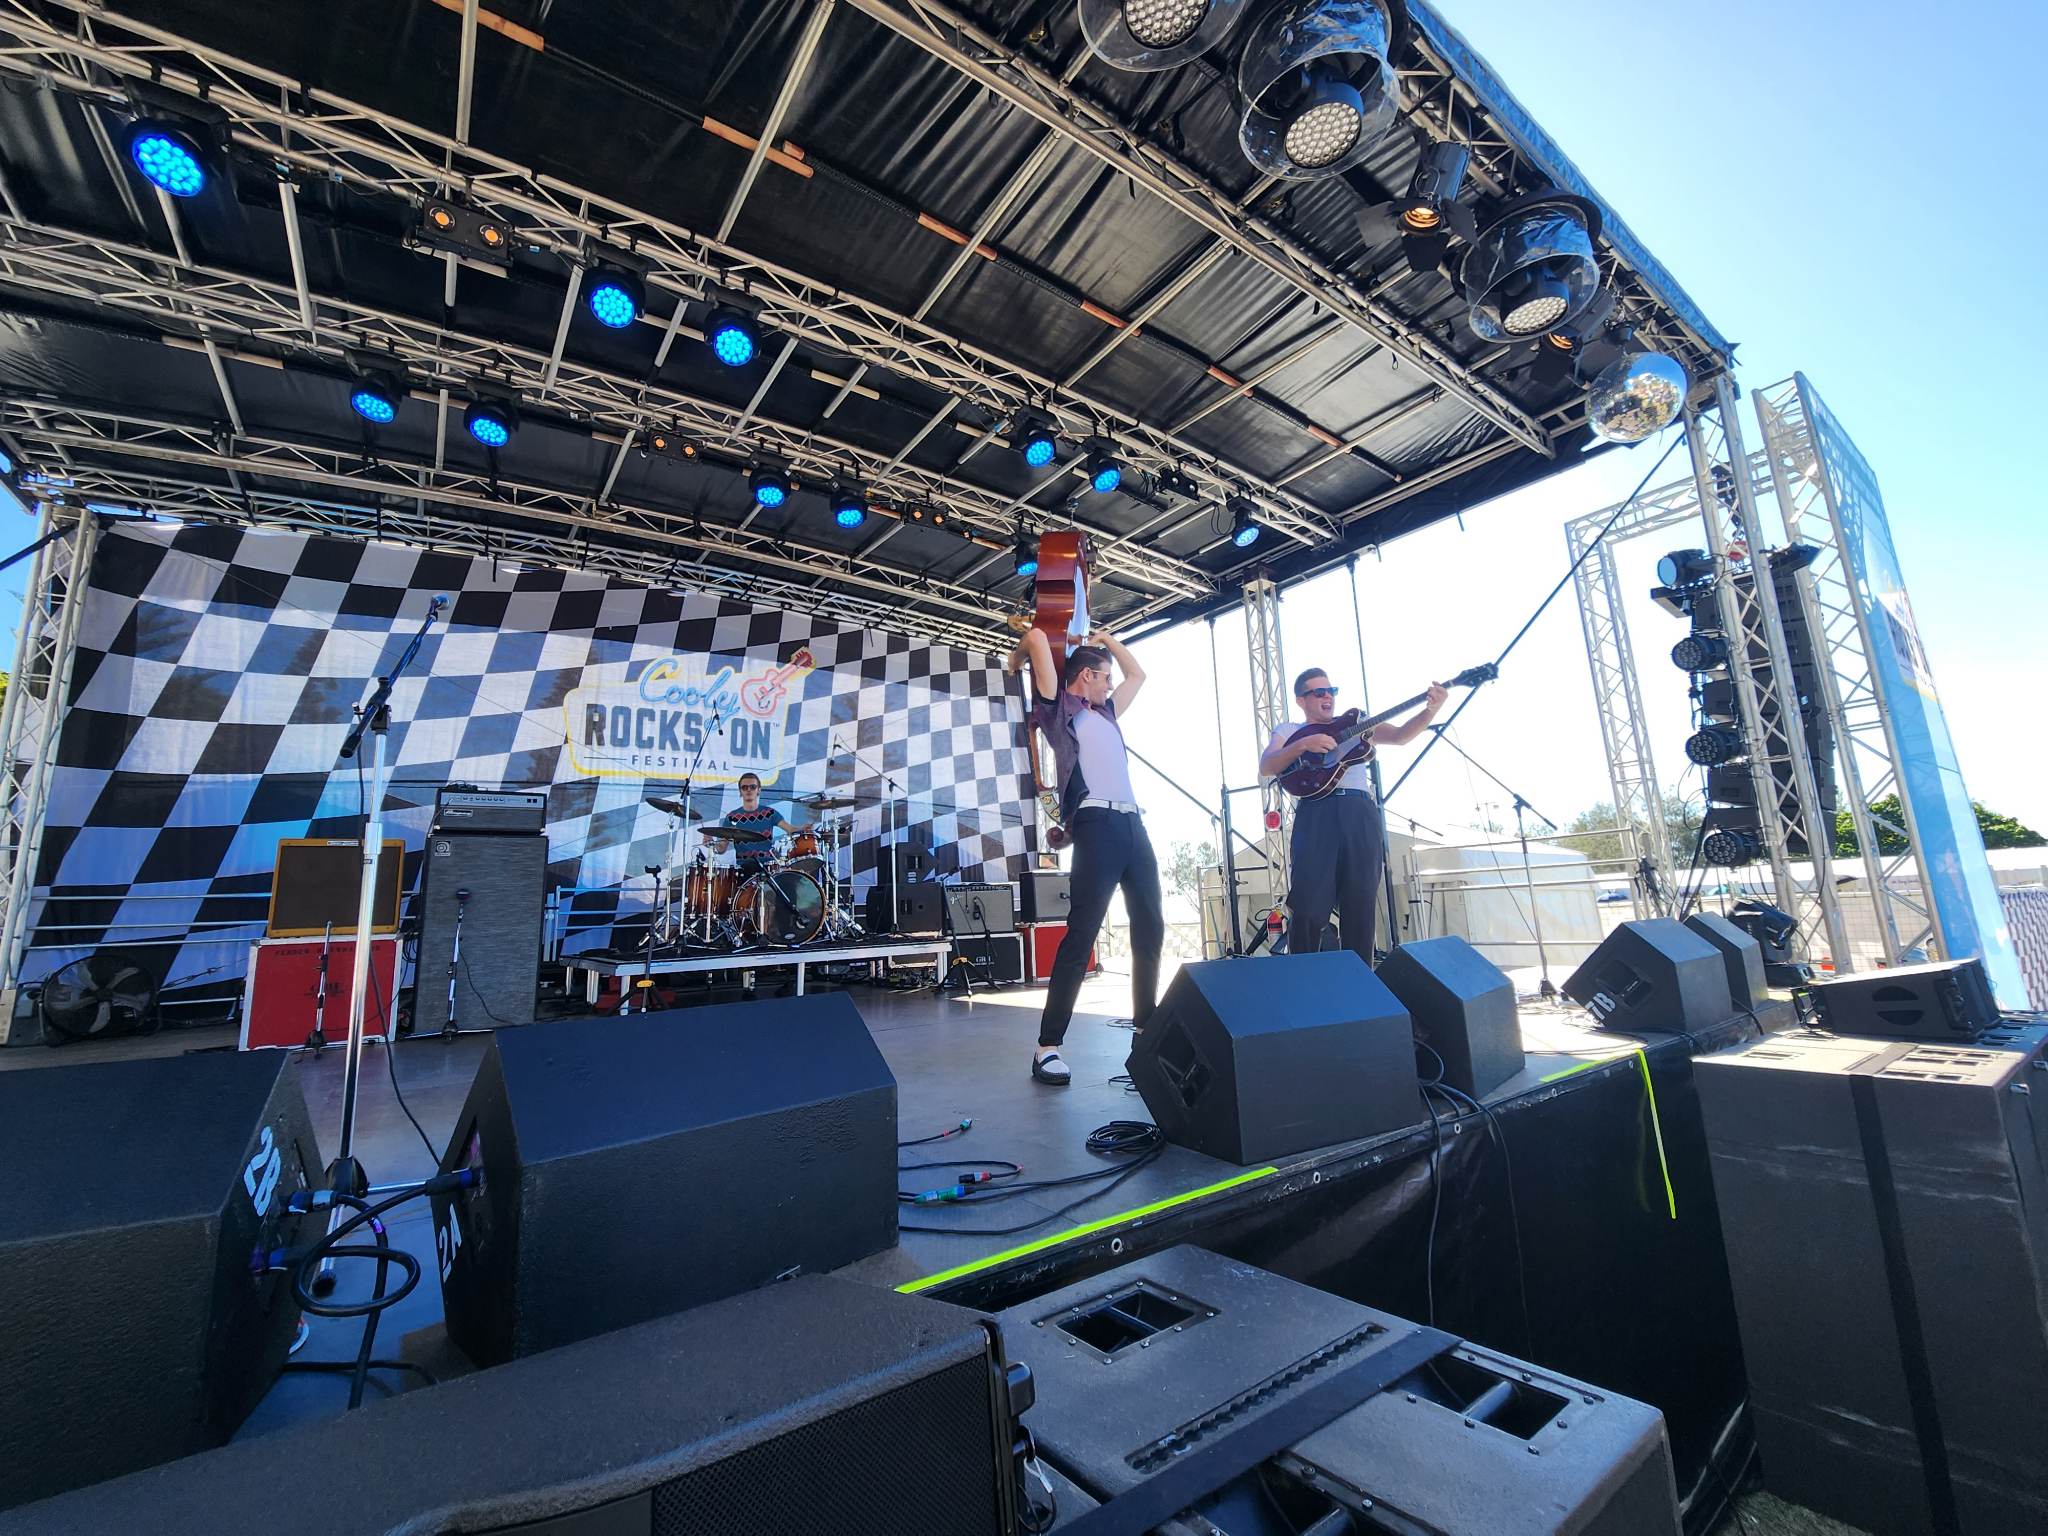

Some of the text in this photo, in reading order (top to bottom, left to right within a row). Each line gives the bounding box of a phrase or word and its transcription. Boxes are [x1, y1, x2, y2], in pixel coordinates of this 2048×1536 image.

[639, 658, 741, 731] Cooly
[584, 703, 772, 760] ROCKS ON
[631, 754, 729, 772] FESTIVAL
[1584, 991, 1617, 1021] 7B
[243, 1125, 282, 1217] 2B
[438, 1203, 463, 1285] 2A
